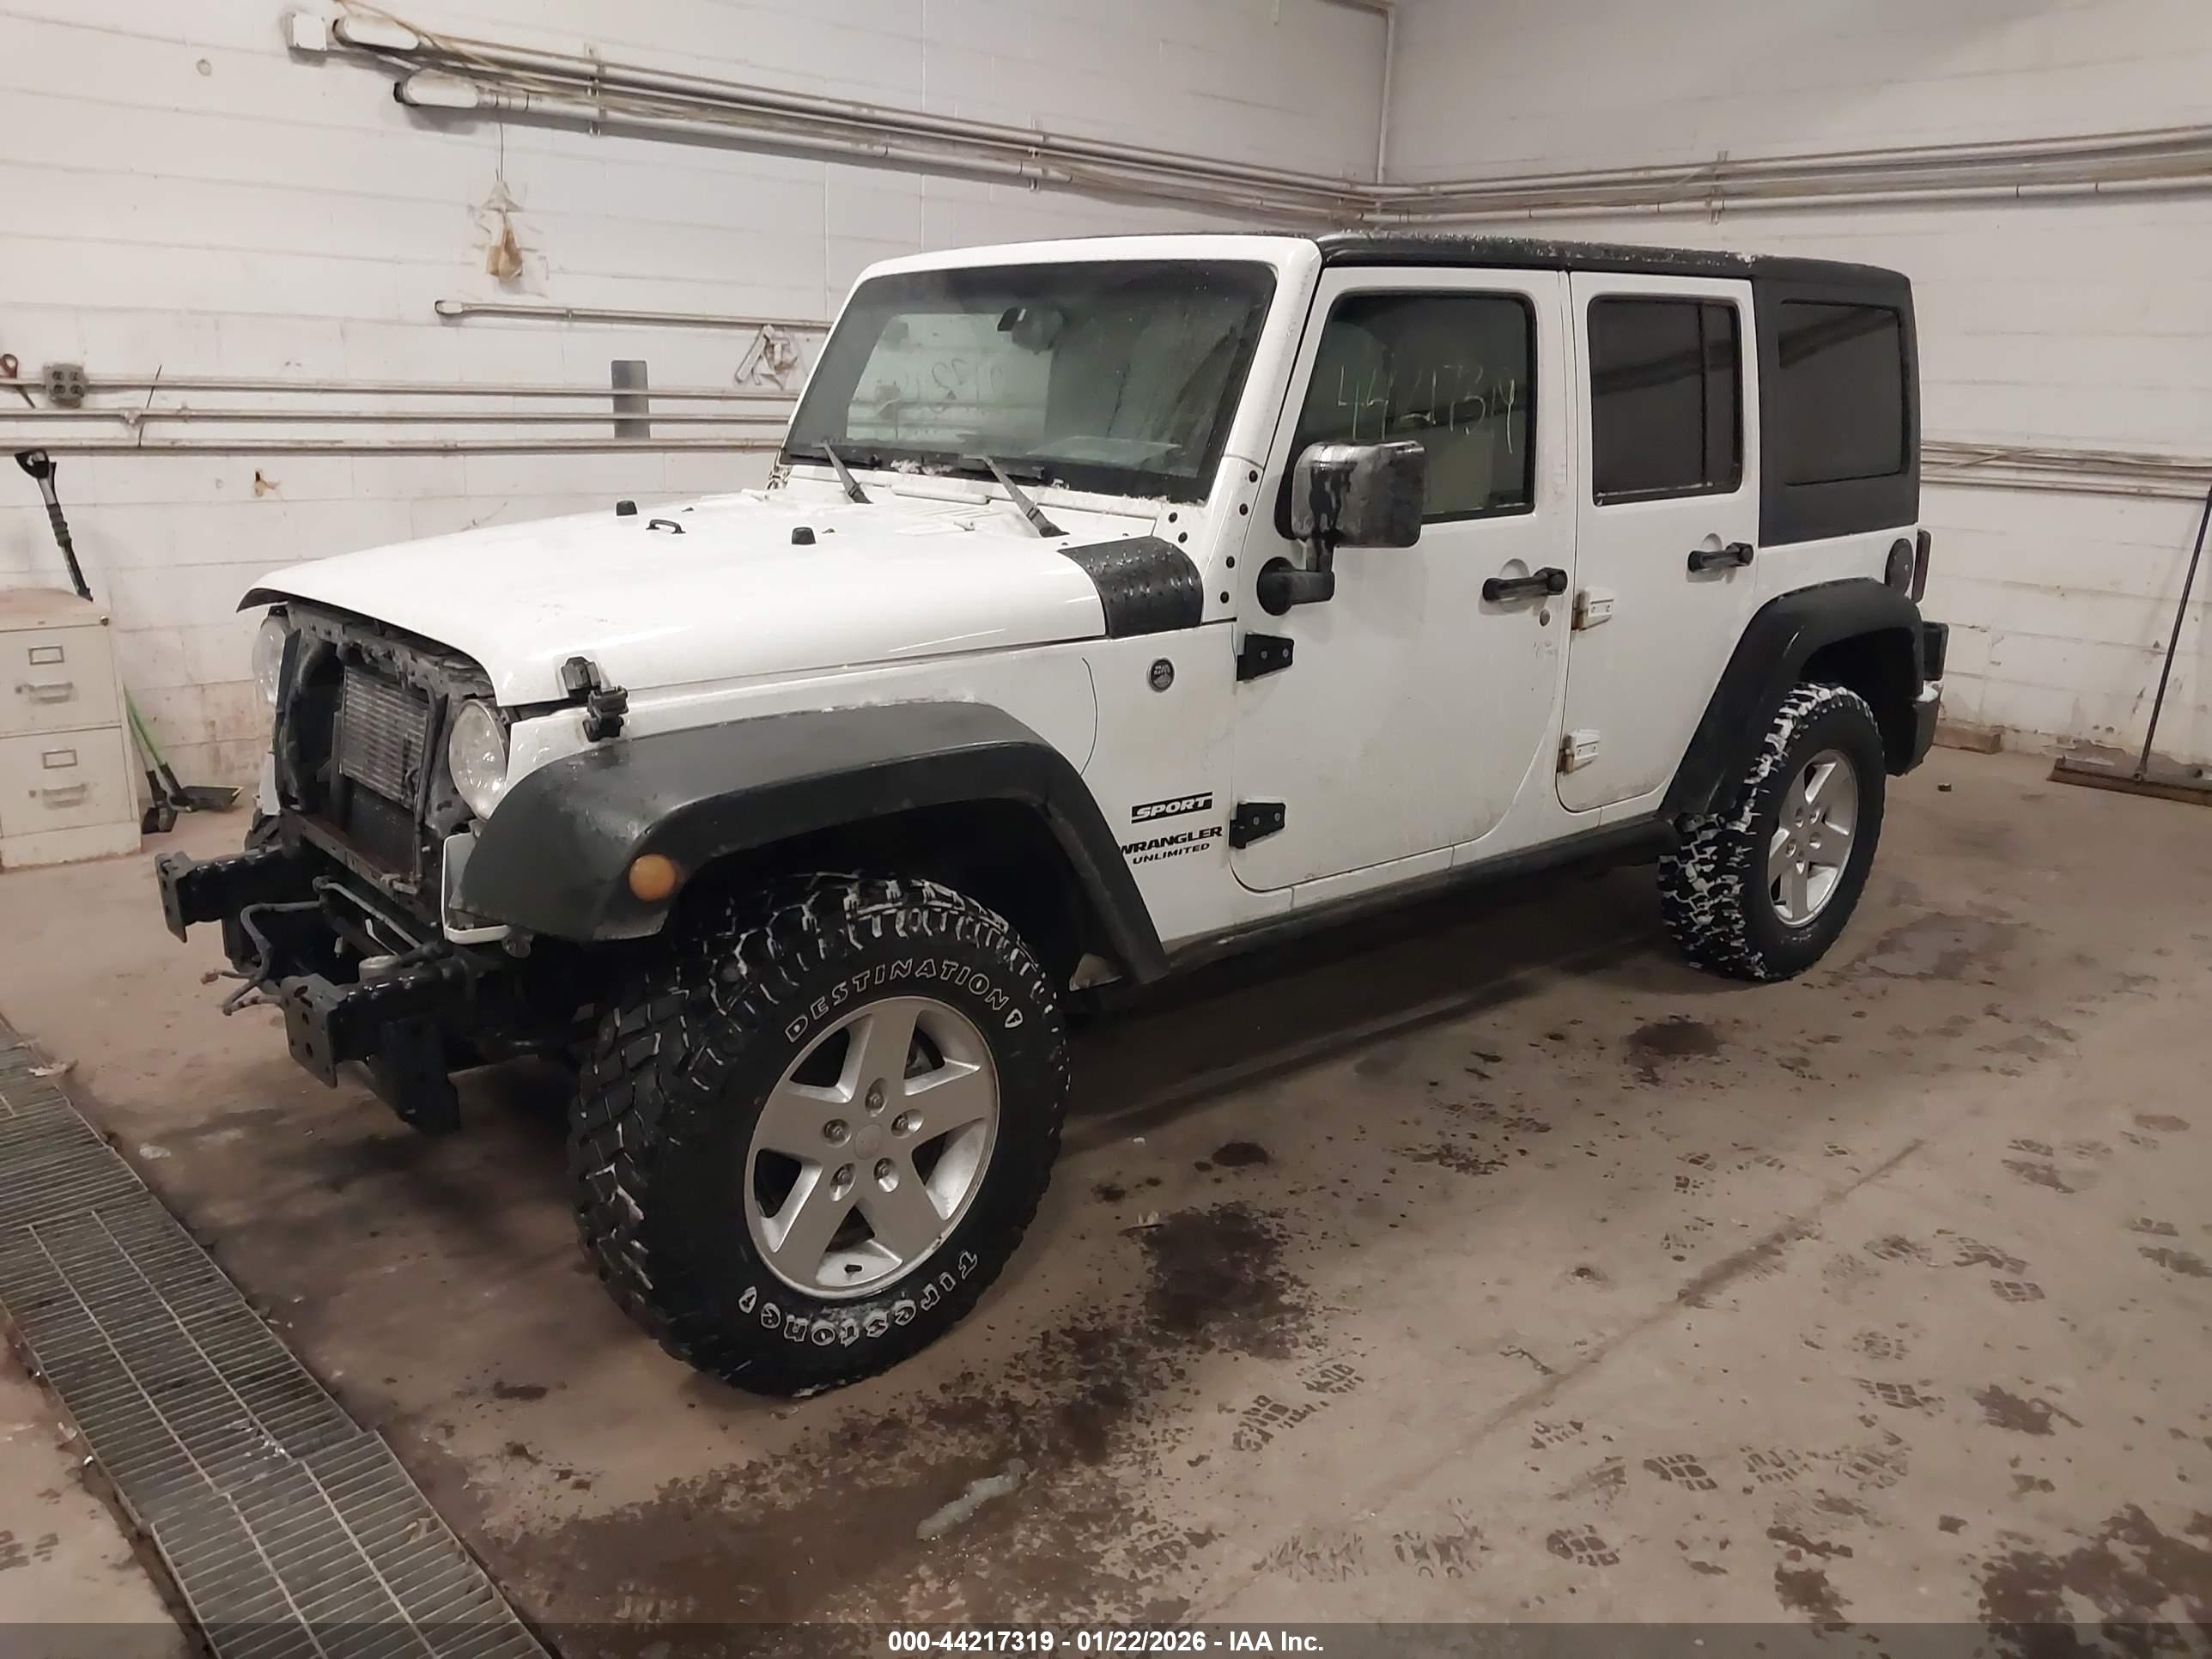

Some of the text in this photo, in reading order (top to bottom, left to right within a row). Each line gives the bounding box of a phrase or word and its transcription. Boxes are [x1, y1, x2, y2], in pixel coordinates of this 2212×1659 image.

[1135, 795, 1212, 819] SPORT
[1133, 842, 1210, 865] UNLIMITED
[785, 950, 1009, 1042] DESTINATION
